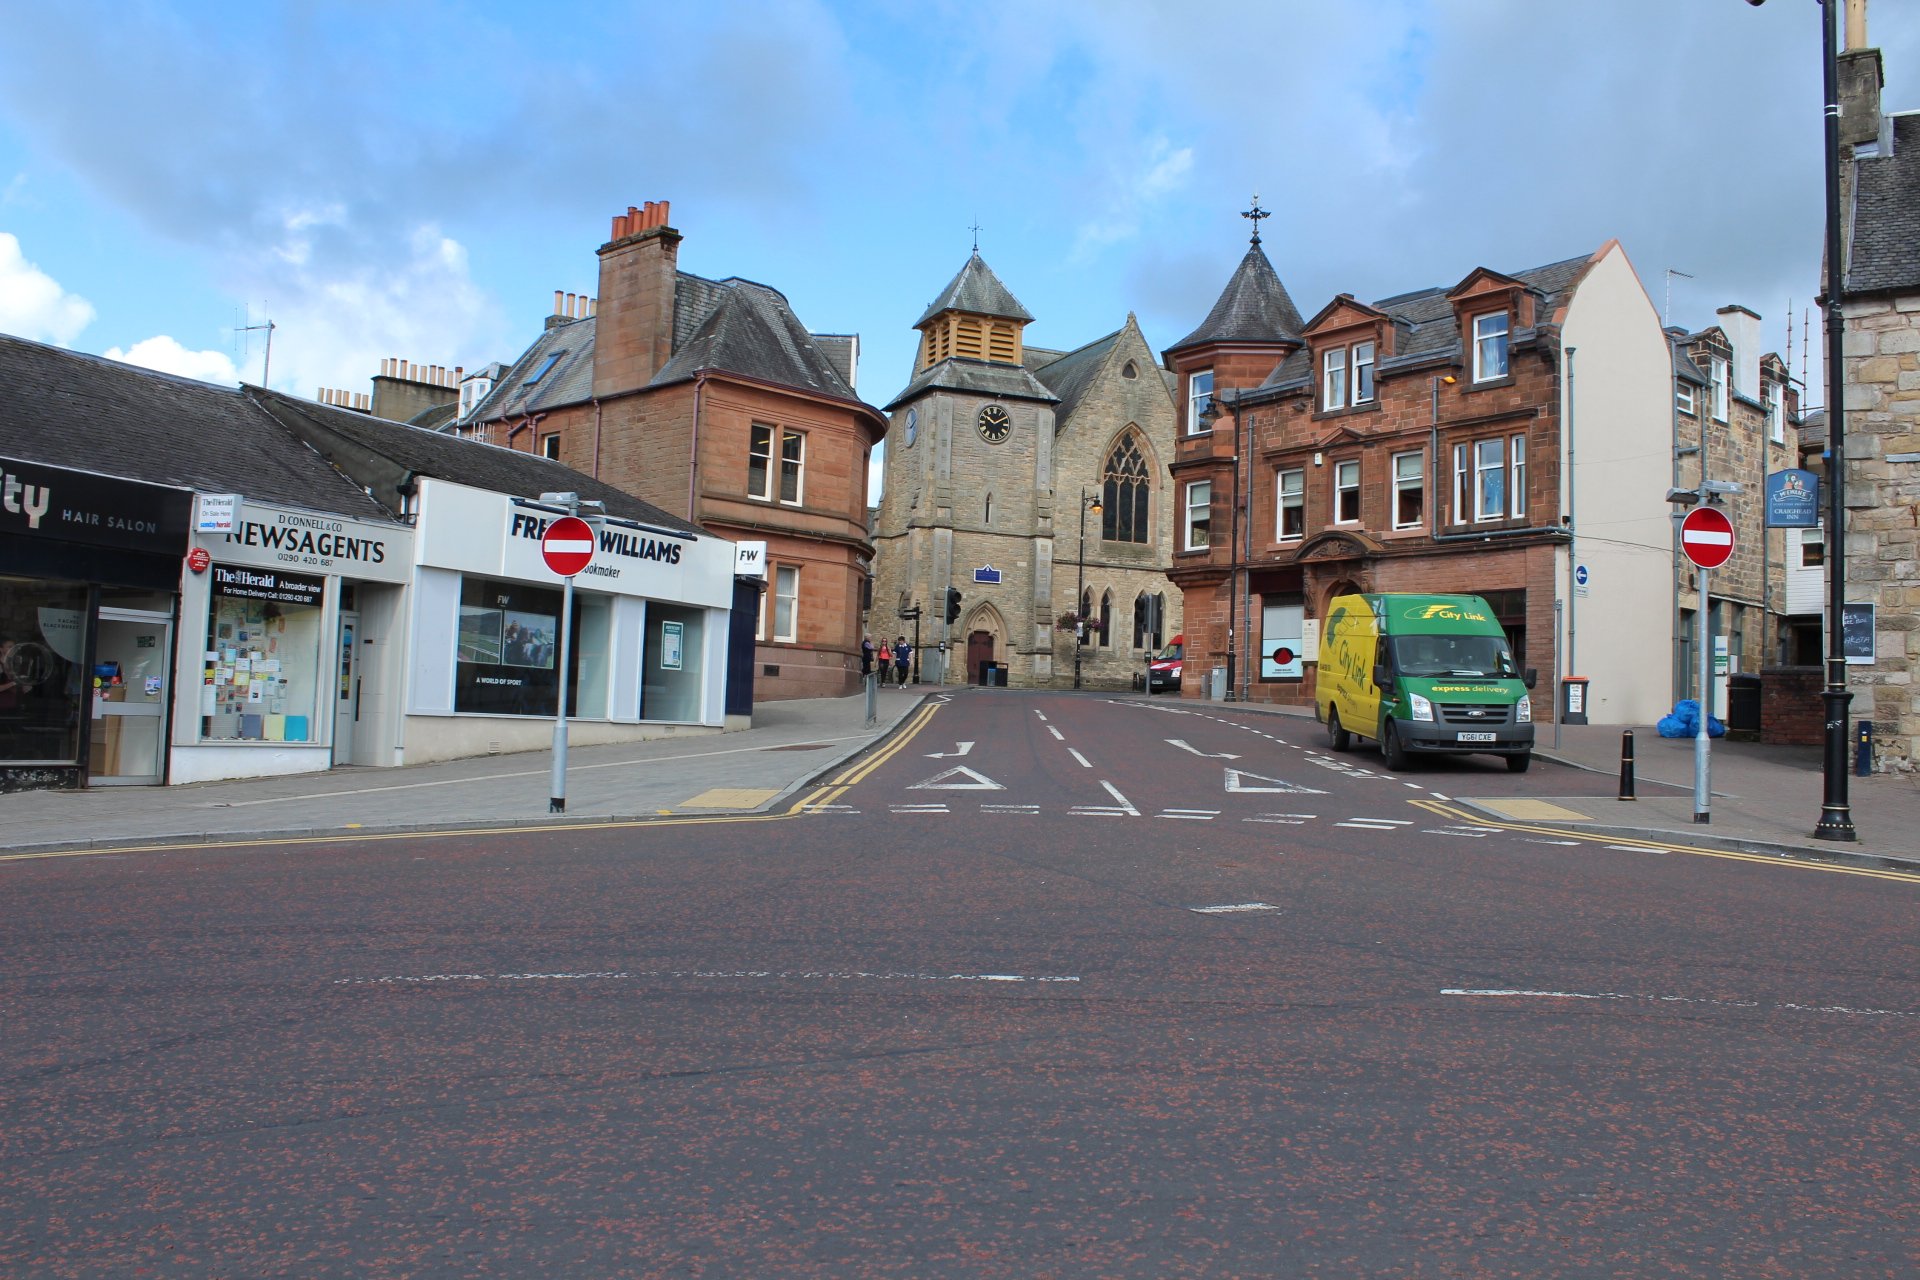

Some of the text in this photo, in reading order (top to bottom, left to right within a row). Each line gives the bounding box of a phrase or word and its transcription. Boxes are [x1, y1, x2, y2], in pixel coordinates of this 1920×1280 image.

[62, 508, 157, 533] HAIR SALON
[278, 514, 343, 532] D CONNELL & CO
[226, 521, 385, 564] NEWSAGENTS
[511, 513, 682, 565] FRE WILLIAMS
[278, 552, 334, 567] 01290 420 687
[740, 550, 759, 561] FW
[215, 568, 275, 588] The Herald
[580, 563, 620, 578] ookmaker
[223, 586, 232, 594] For
[232, 587, 248, 596] Home
[248, 589, 268, 599] Delivery
[293, 594, 304, 602] 420
[279, 581, 321, 593] A broader view
[497, 595, 510, 605] FW
[1439, 610, 1487, 622] City Link
[1339, 639, 1353, 680] City
[1352, 652, 1367, 691] Link
[481, 677, 499, 685] WORLD
[1472, 685, 1509, 695] delivery
[1461, 733, 1492, 741] YG61 CXE
